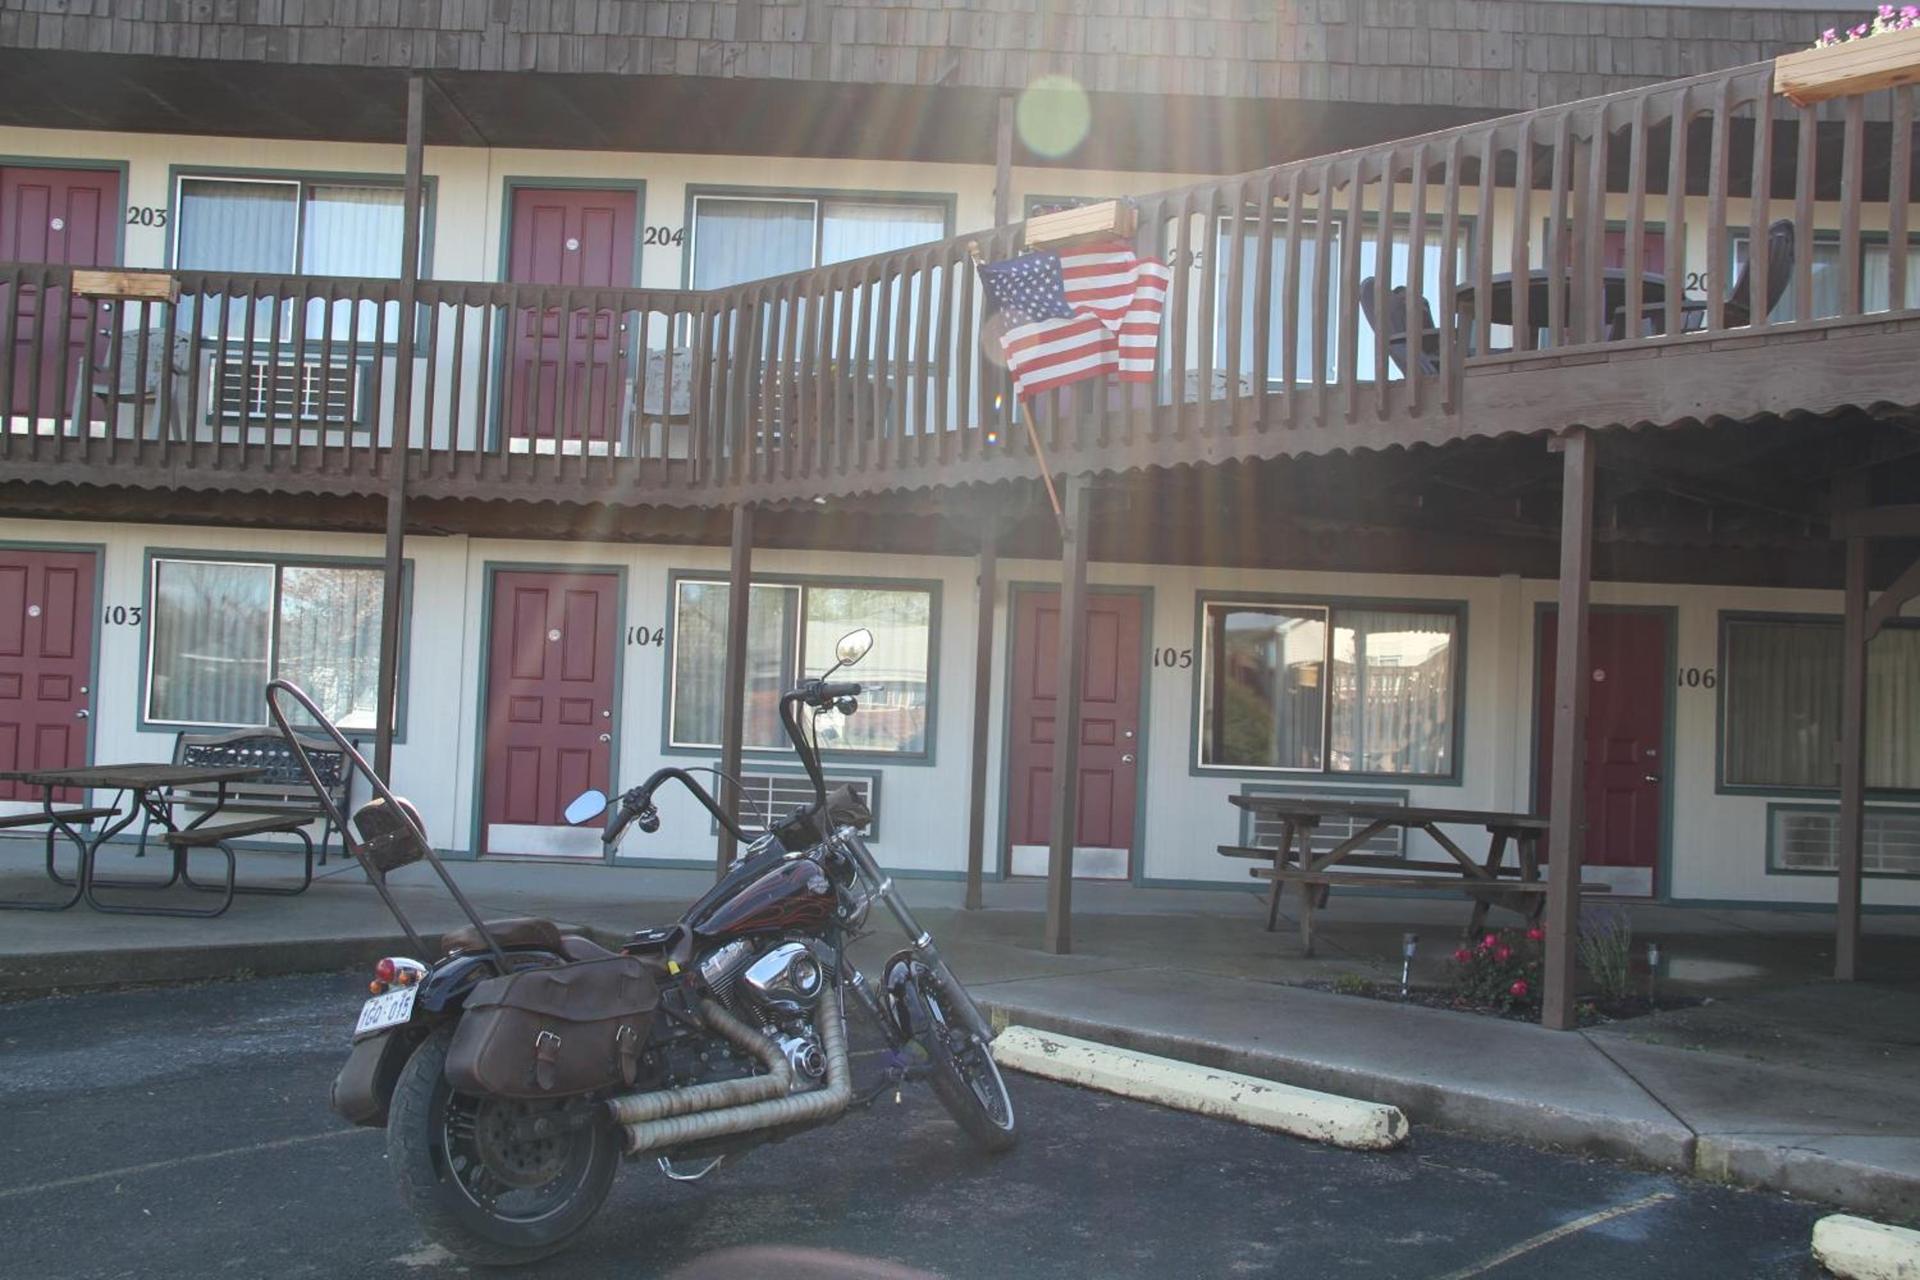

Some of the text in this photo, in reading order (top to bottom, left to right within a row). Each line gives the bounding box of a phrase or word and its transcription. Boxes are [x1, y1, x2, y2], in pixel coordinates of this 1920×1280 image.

[127, 206, 168, 228] 203
[643, 226, 685, 247] 204
[1167, 248, 1203, 270] 25
[104, 605, 142, 626] 103
[627, 626, 665, 647] 104
[1153, 648, 1193, 669] 105
[1677, 667, 1716, 688] 106
